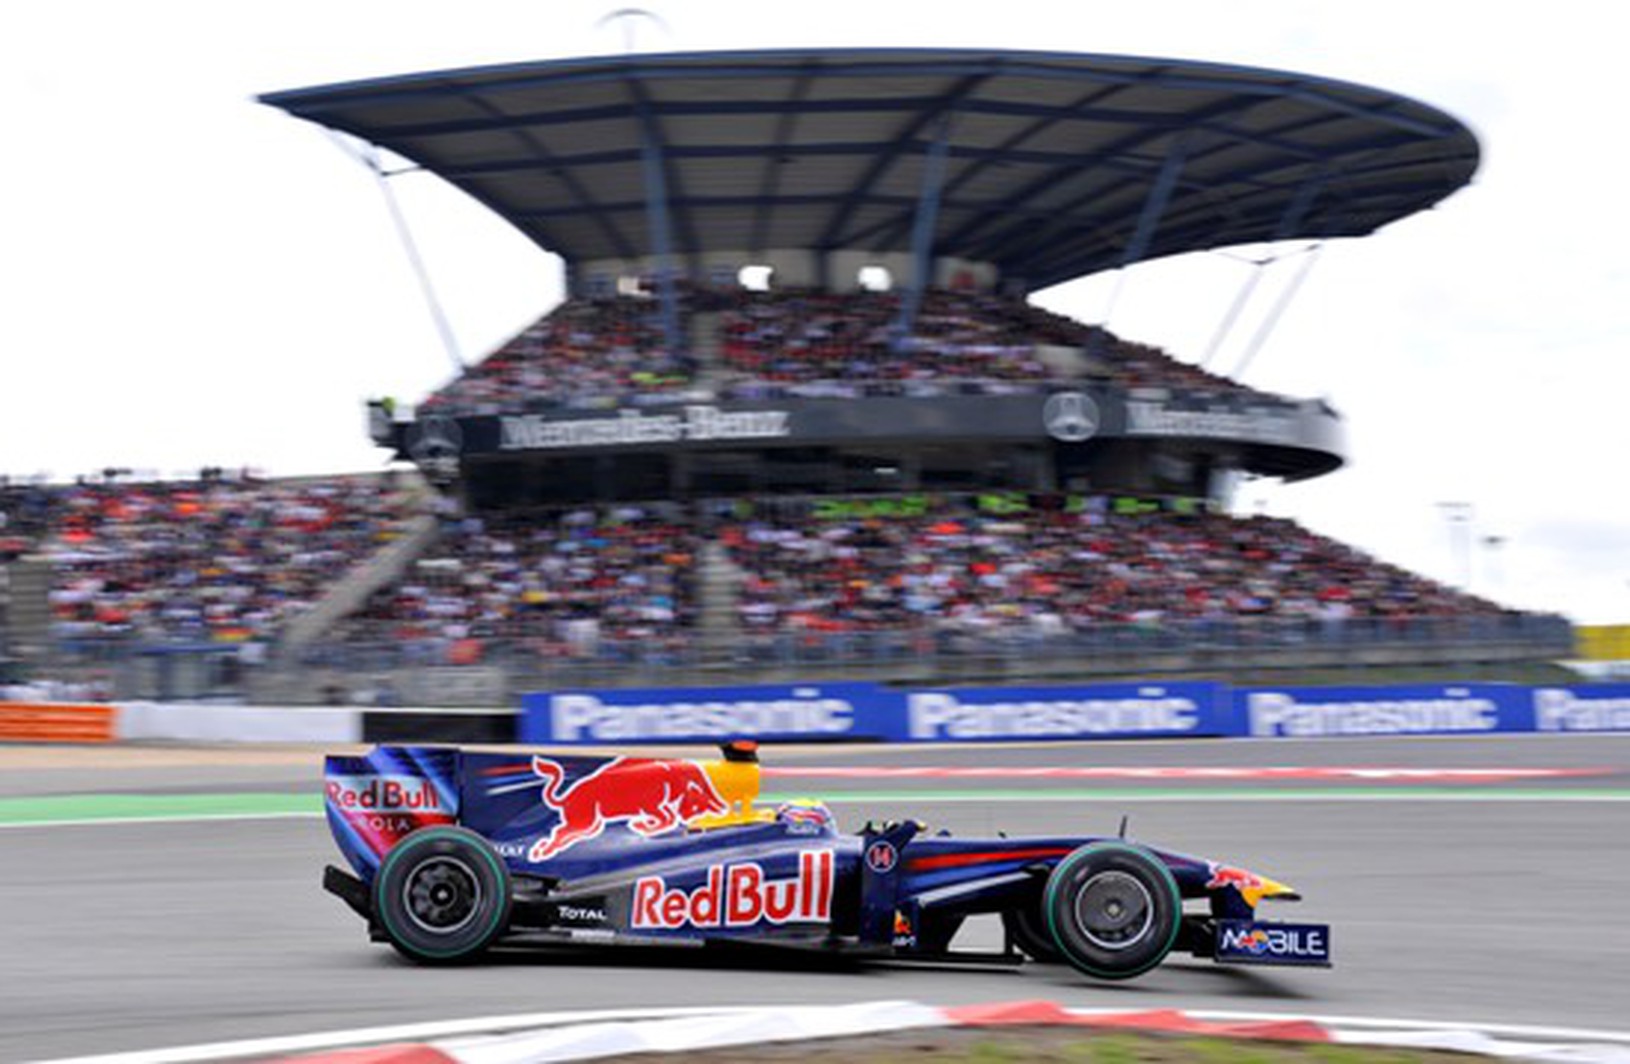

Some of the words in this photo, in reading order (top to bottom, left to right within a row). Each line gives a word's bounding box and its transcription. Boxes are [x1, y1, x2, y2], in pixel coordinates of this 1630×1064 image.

[551, 688, 854, 741] Panasonic
[908, 687, 1198, 738] Panasonic
[1248, 688, 1499, 736] Panasonic
[326, 779, 378, 807] Red
[383, 780, 438, 809] Bull
[356, 817, 410, 832] OLA
[558, 905, 608, 920] TOTAL
[631, 864, 724, 929] Red
[725, 849, 834, 926] Bull
